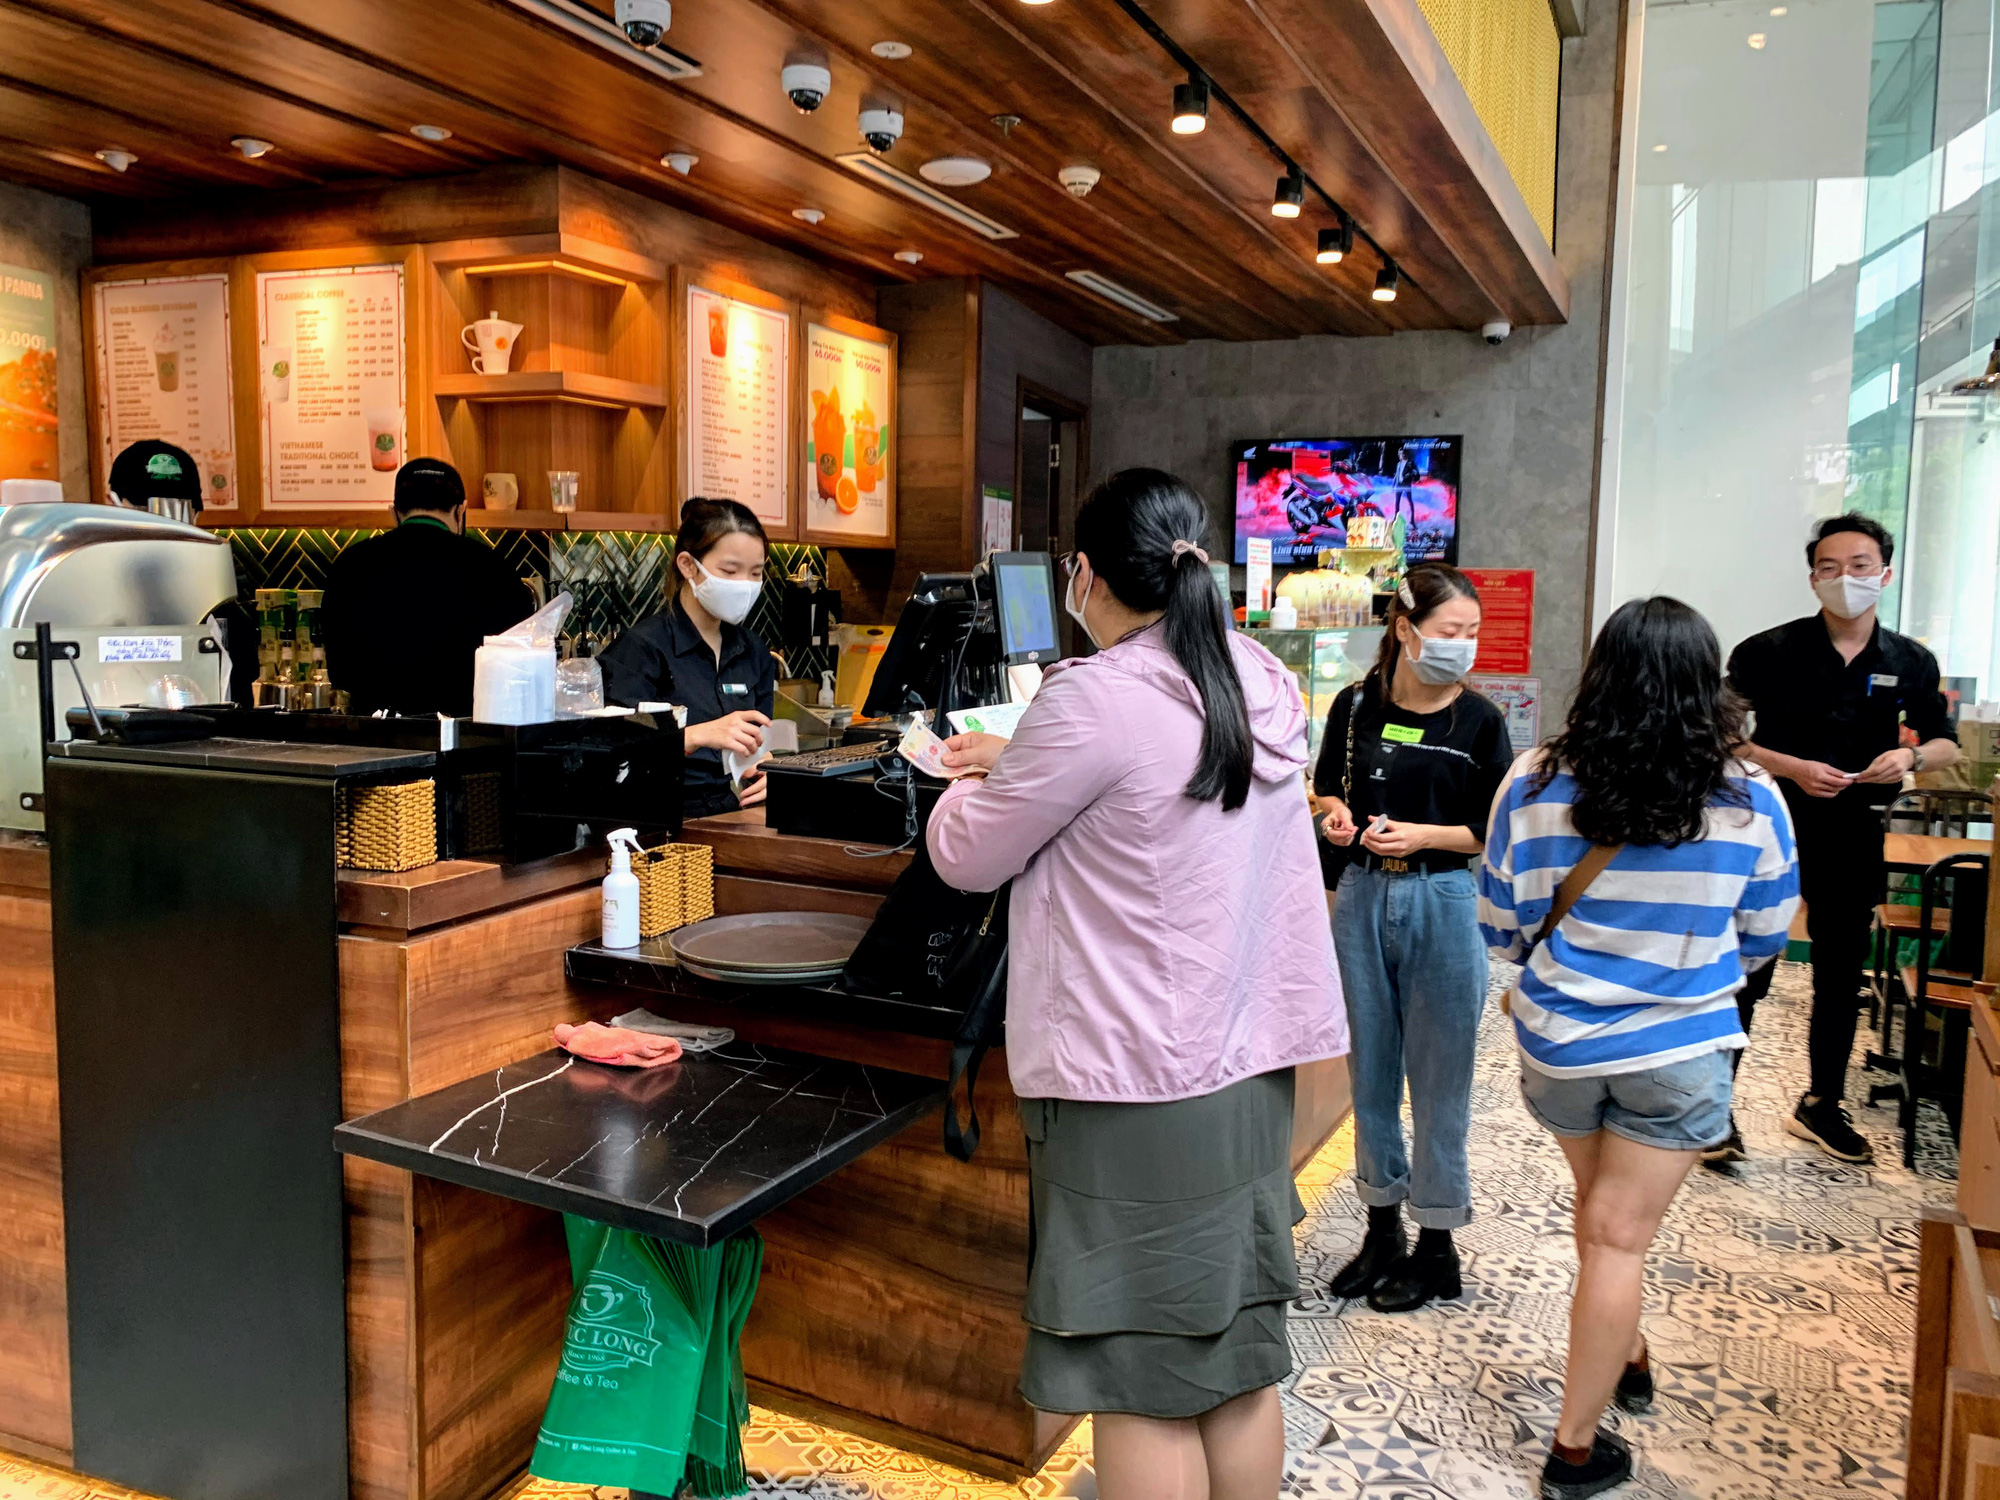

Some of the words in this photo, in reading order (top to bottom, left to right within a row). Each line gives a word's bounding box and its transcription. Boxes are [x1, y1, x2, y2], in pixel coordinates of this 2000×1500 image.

[275, 290, 314, 302] CLASSICAL
[317, 289, 344, 299] COFFEE
[280, 441, 323, 449] VIETNAMESE
[280, 452, 327, 460] TRADITIONAL
[329, 451, 359, 460] CHOICE
[568, 1324, 587, 1344] UC
[591, 1330, 648, 1357] LONG
[568, 1349, 585, 1359] Since
[588, 1353, 605, 1361] 1968
[556, 1368, 580, 1385] offee
[583, 1374, 593, 1387] &
[597, 1375, 618, 1390] Tea
